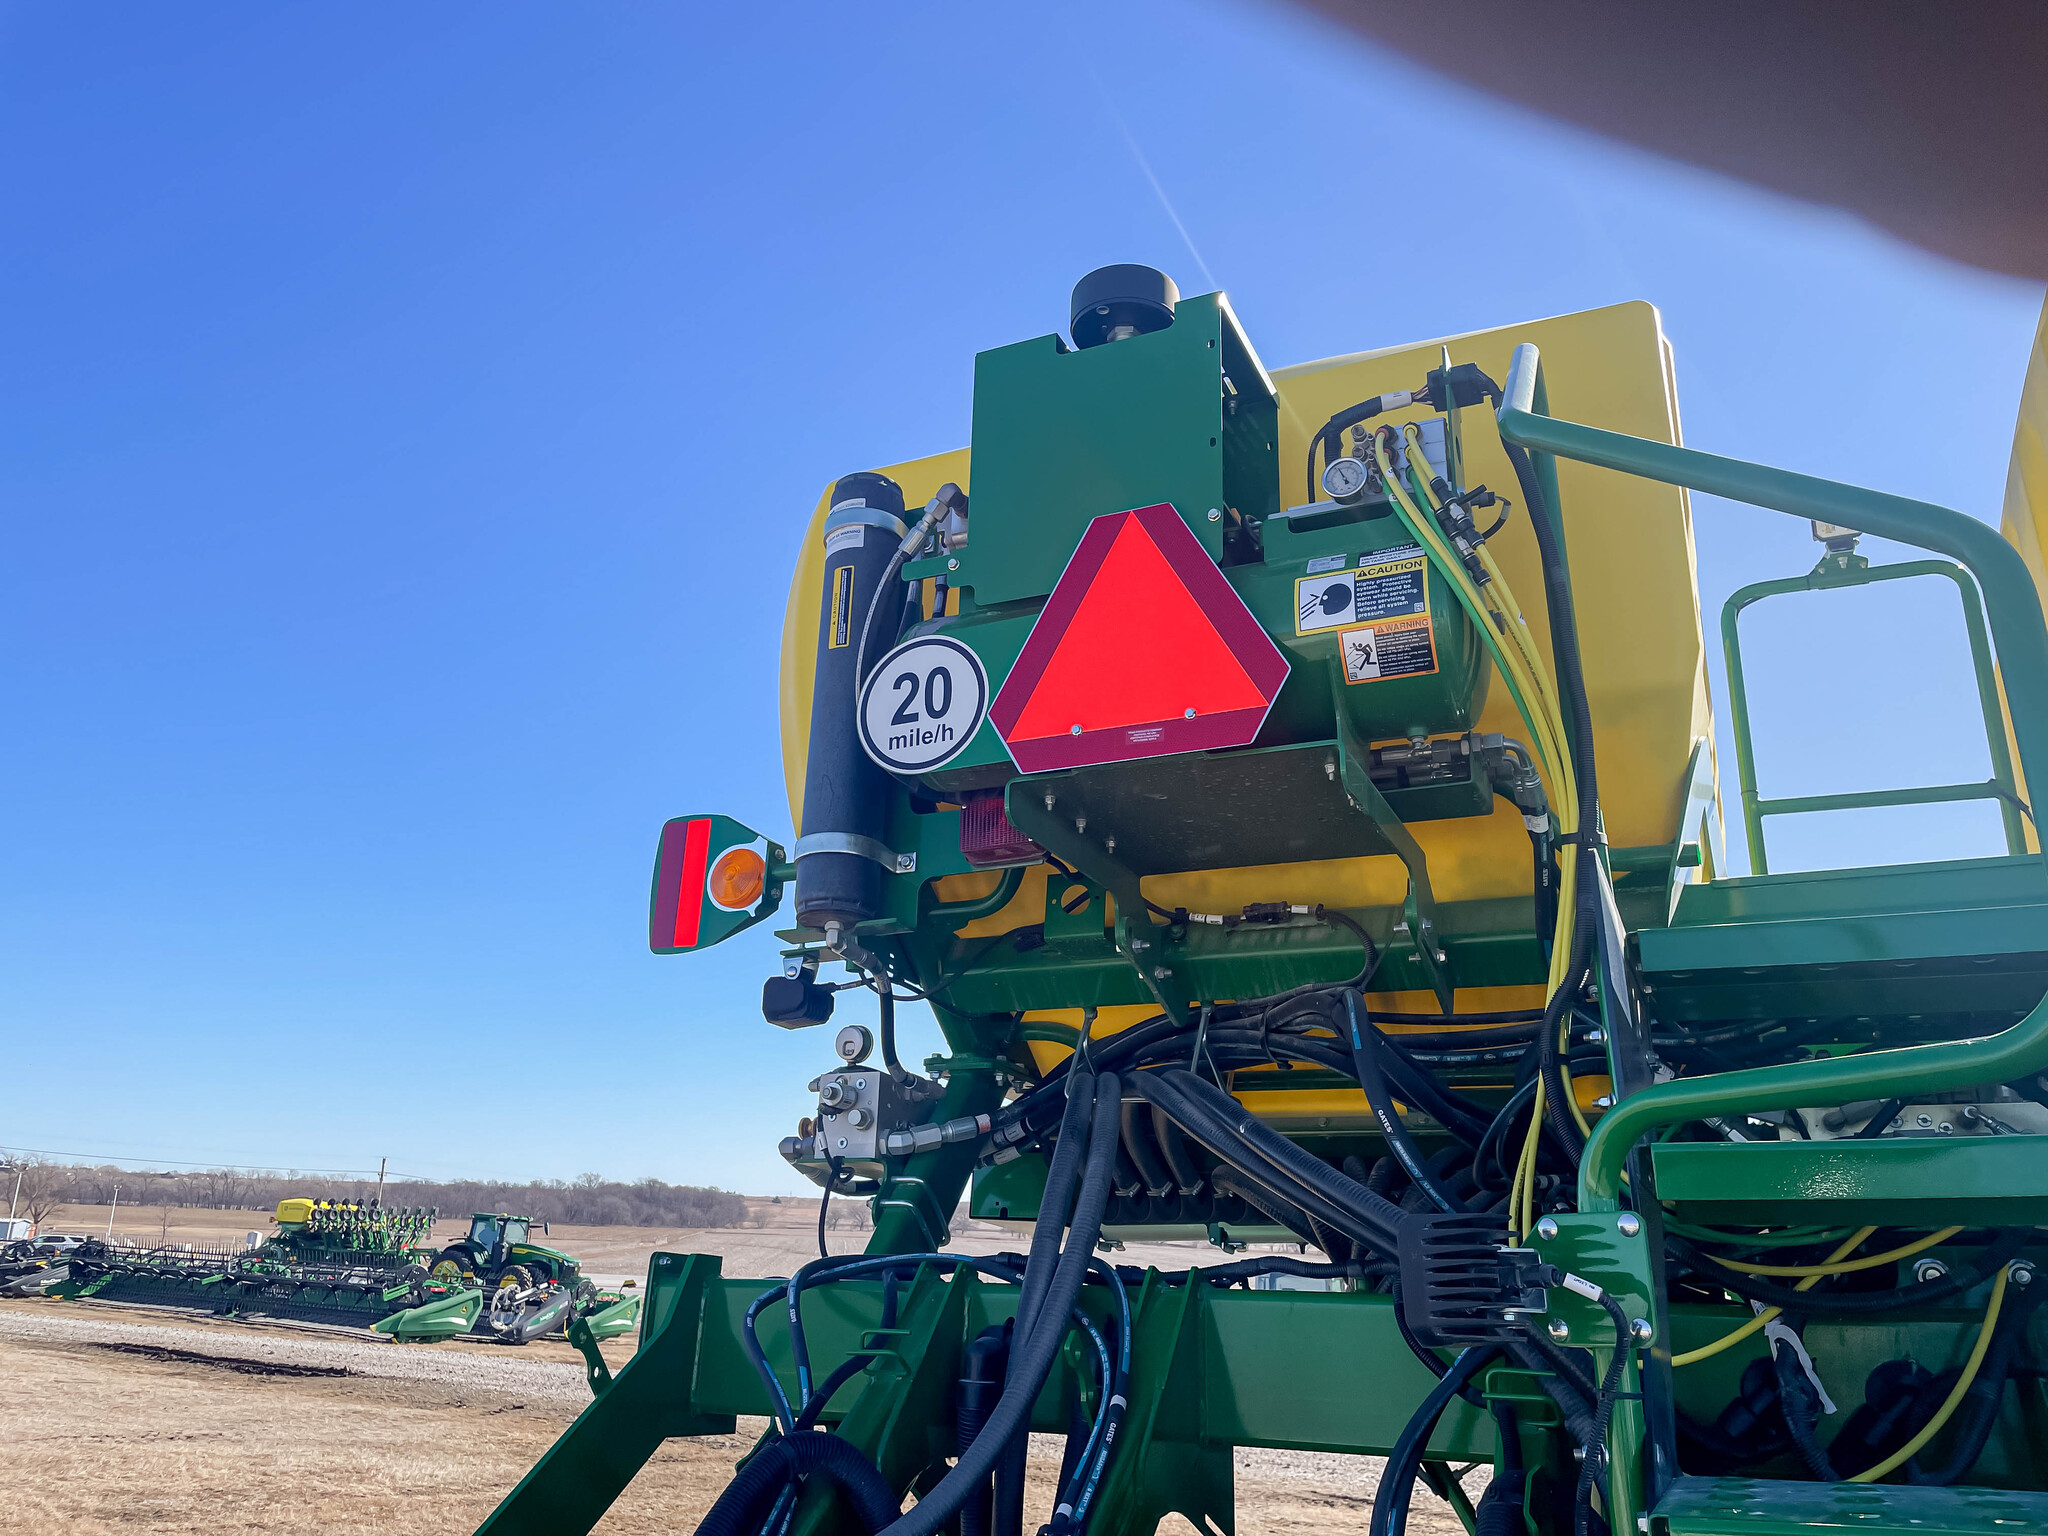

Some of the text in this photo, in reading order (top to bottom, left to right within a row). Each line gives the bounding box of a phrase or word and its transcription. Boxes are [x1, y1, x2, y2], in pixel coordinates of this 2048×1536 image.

[1373, 544, 1414, 554] IMPORTANT
[1368, 560, 1422, 575] CAUTION
[1376, 574, 1411, 584] pressurized
[1358, 610, 1385, 618] pressure.
[1385, 619, 1428, 631] WARNING
[890, 666, 953, 726] 20
[889, 724, 954, 750] mile/h
[1378, 1110, 1393, 1133] GATES
[1106, 1422, 1116, 1444] GATES
